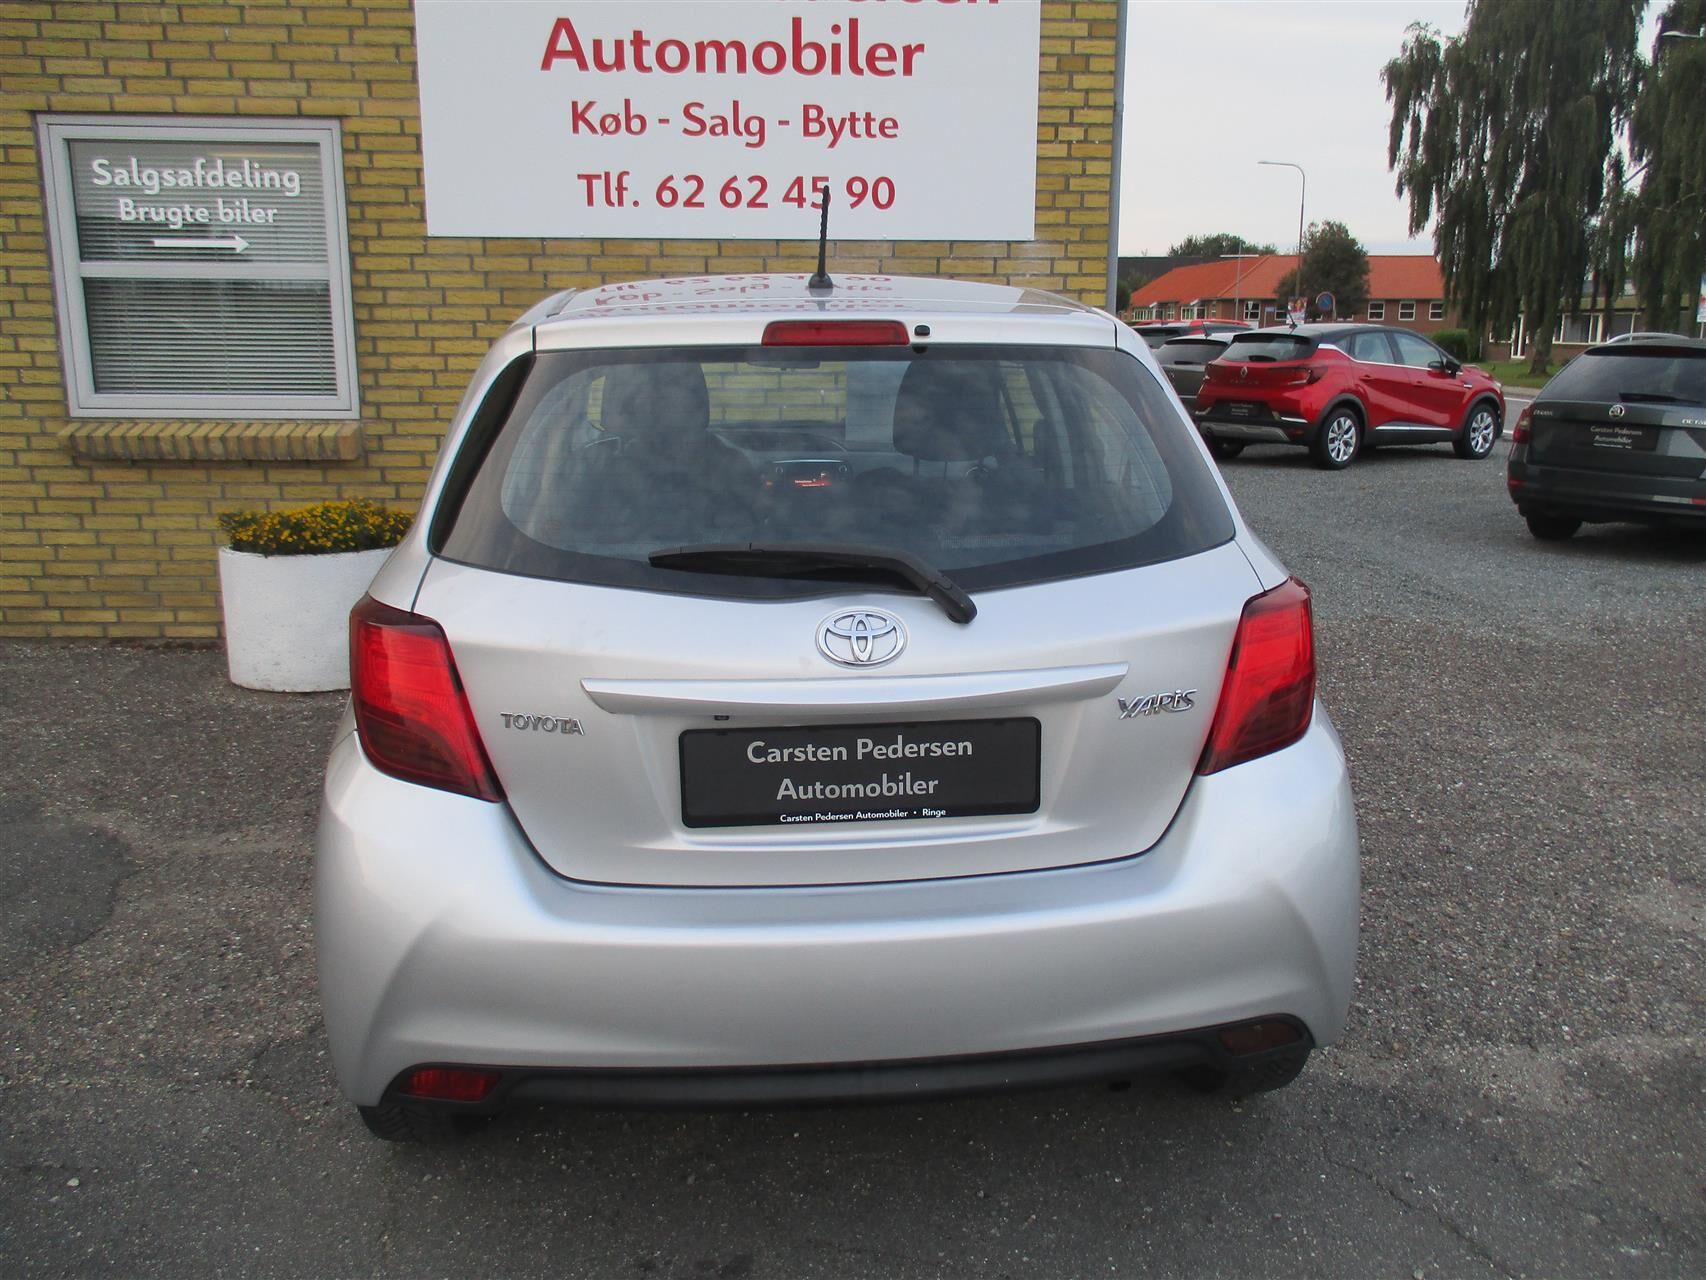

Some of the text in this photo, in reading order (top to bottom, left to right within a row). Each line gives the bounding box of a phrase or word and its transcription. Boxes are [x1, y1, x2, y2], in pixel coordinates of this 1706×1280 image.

[541, 17, 925, 77] Automobiler
[570, 98, 648, 137] Køb
[682, 99, 766, 149] Salg
[802, 104, 899, 148] Bytte
[91, 157, 301, 197] Salgsafdeling
[576, 171, 896, 210] Tlf. 62 62 45 90
[118, 198, 278, 229] Brugte biler
[500, 711, 585, 736] TOYOTA
[747, 735, 973, 764] Carsten Pedersen
[776, 771, 939, 801] Automobiler
[780, 808, 946, 823] Carsten Pedersen Automobiler Ringe
